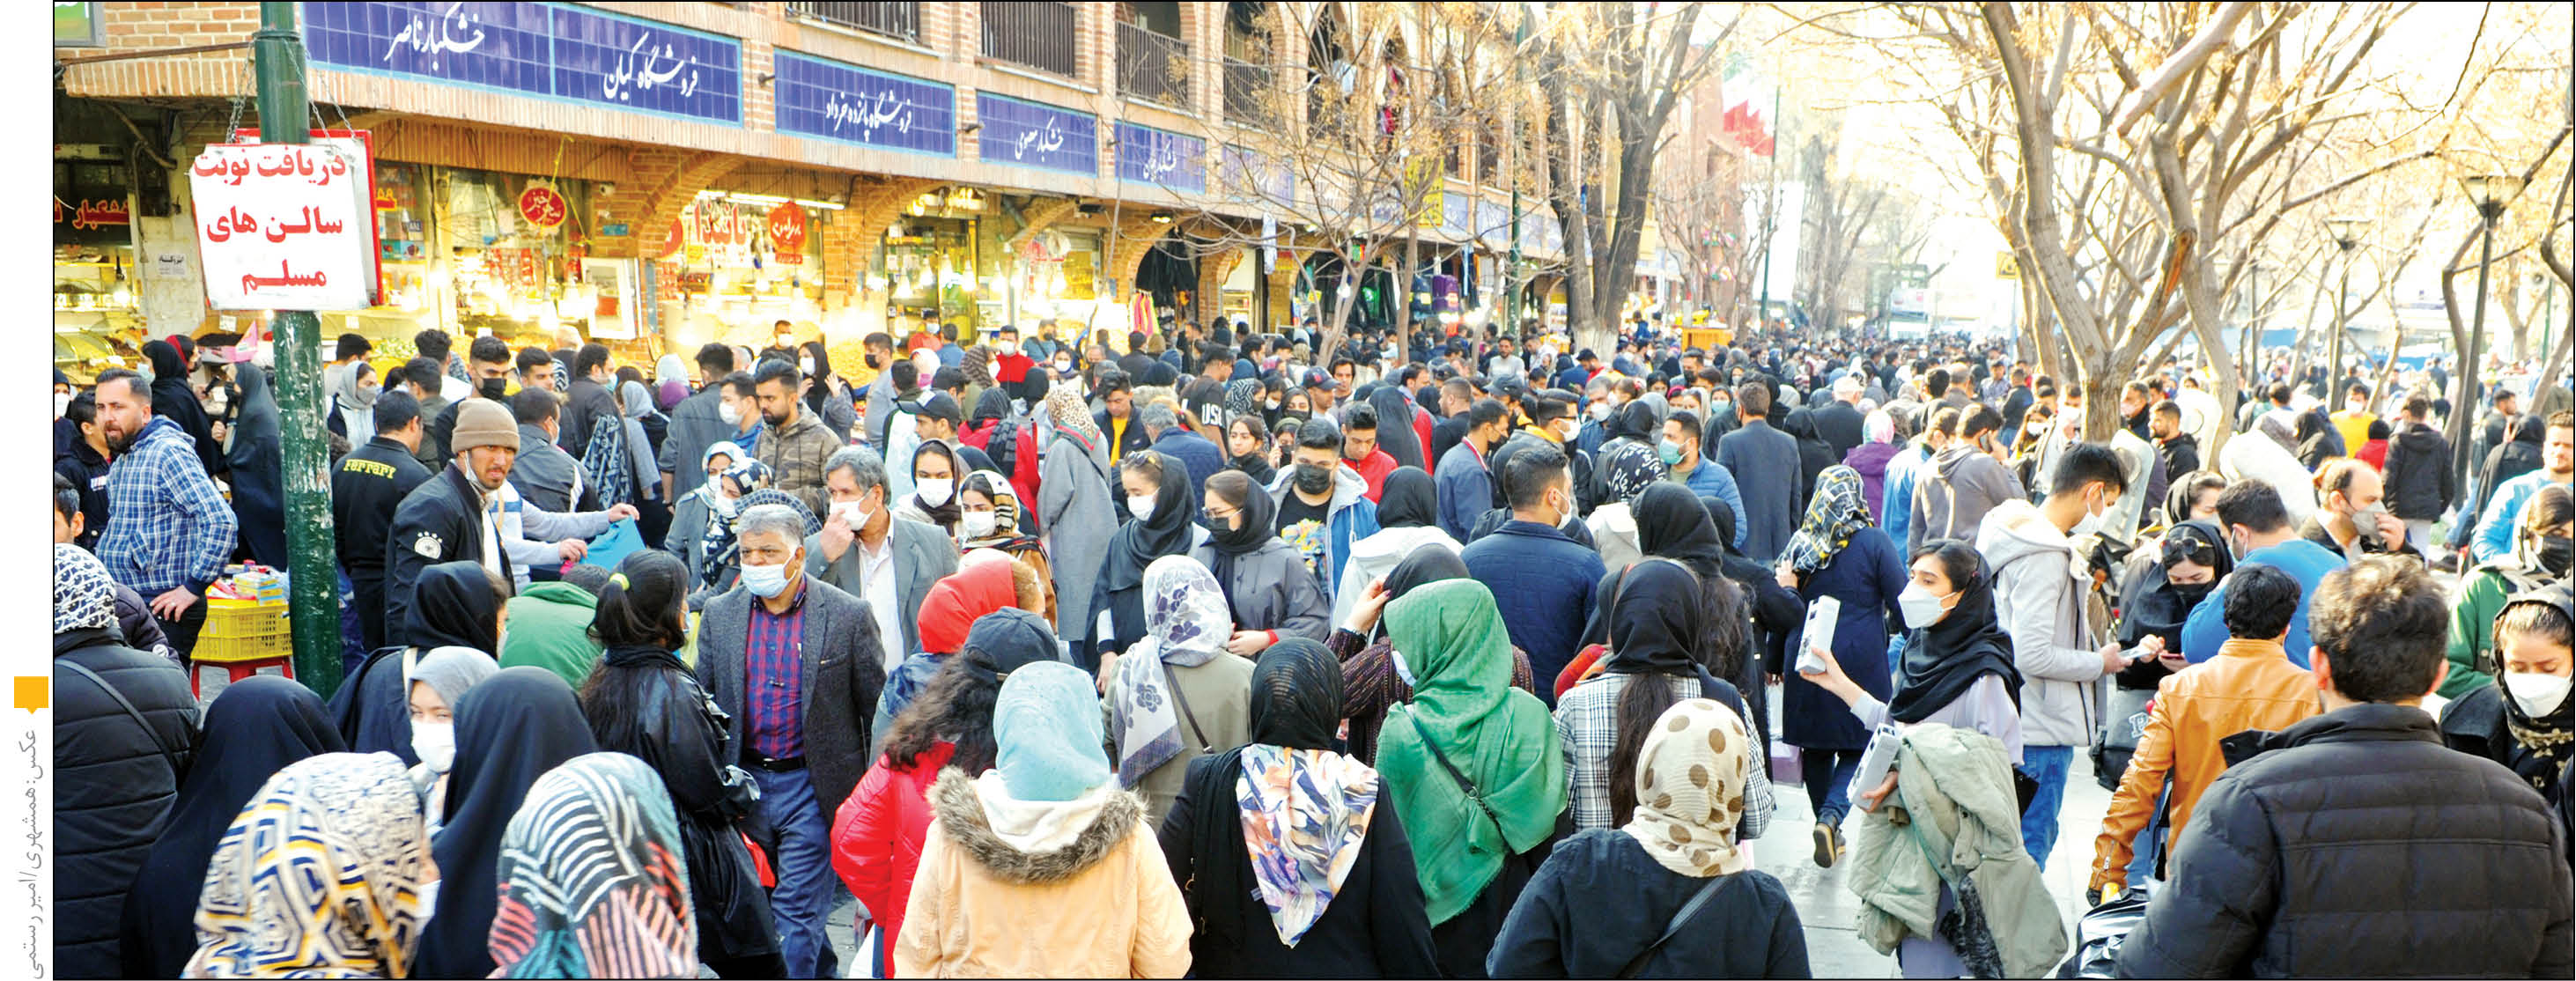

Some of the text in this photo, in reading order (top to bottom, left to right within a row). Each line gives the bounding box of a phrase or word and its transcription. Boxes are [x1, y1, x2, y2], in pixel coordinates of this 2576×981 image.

[383, 2, 485, 71] خشکبار ناصر
[603, 30, 698, 100] فروشگاه کیان
[825, 89, 912, 143] فروشگاه پانزده خرداد
[1037, 115, 1065, 163] خشکبار
[194, 145, 347, 186] دریافت نوبت
[72, 198, 129, 230] شکبار
[207, 205, 343, 243] سالن های
[241, 258, 327, 296] مسلم
[343, 459, 397, 479] Ferrari
